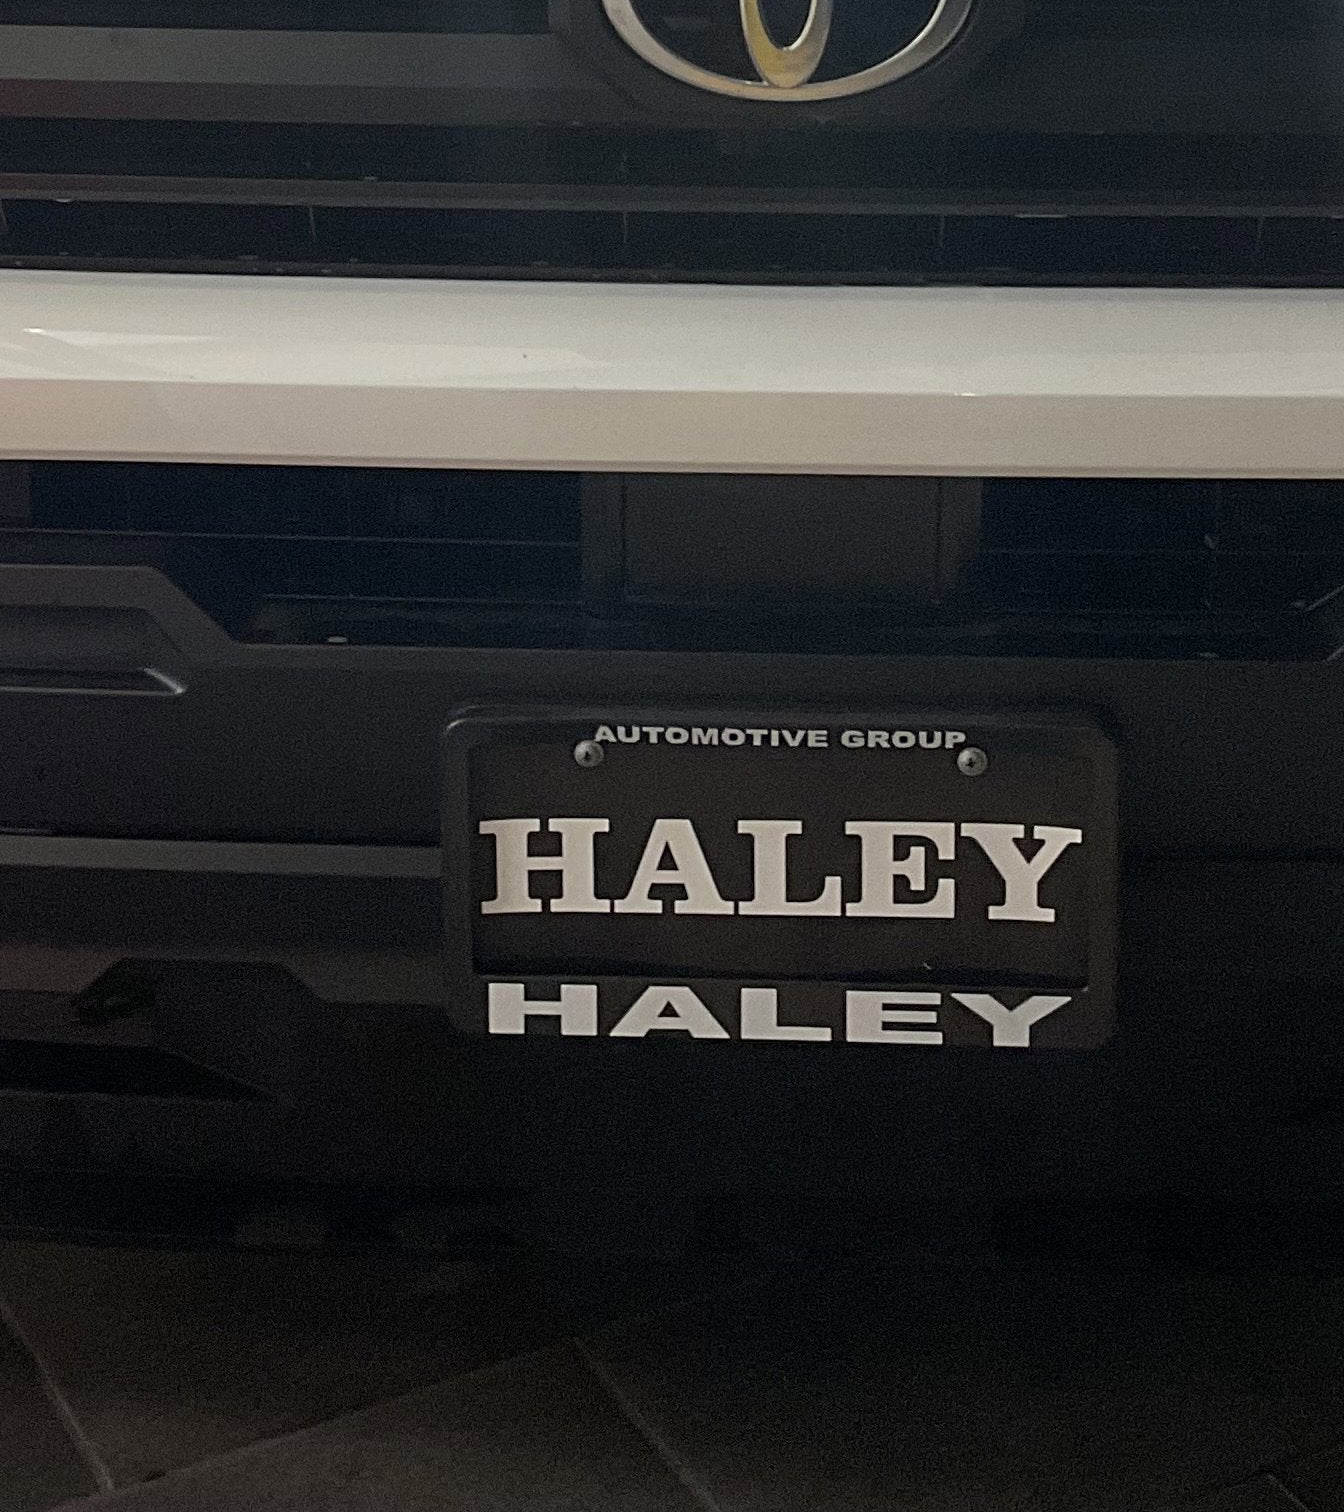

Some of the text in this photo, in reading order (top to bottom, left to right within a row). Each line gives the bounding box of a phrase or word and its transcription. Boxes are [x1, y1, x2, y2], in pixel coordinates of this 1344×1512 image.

[593, 724, 967, 750] AUTOMOTIVE GROUP
[479, 817, 1083, 923] HALEY
[487, 982, 1072, 1048] HALEY
